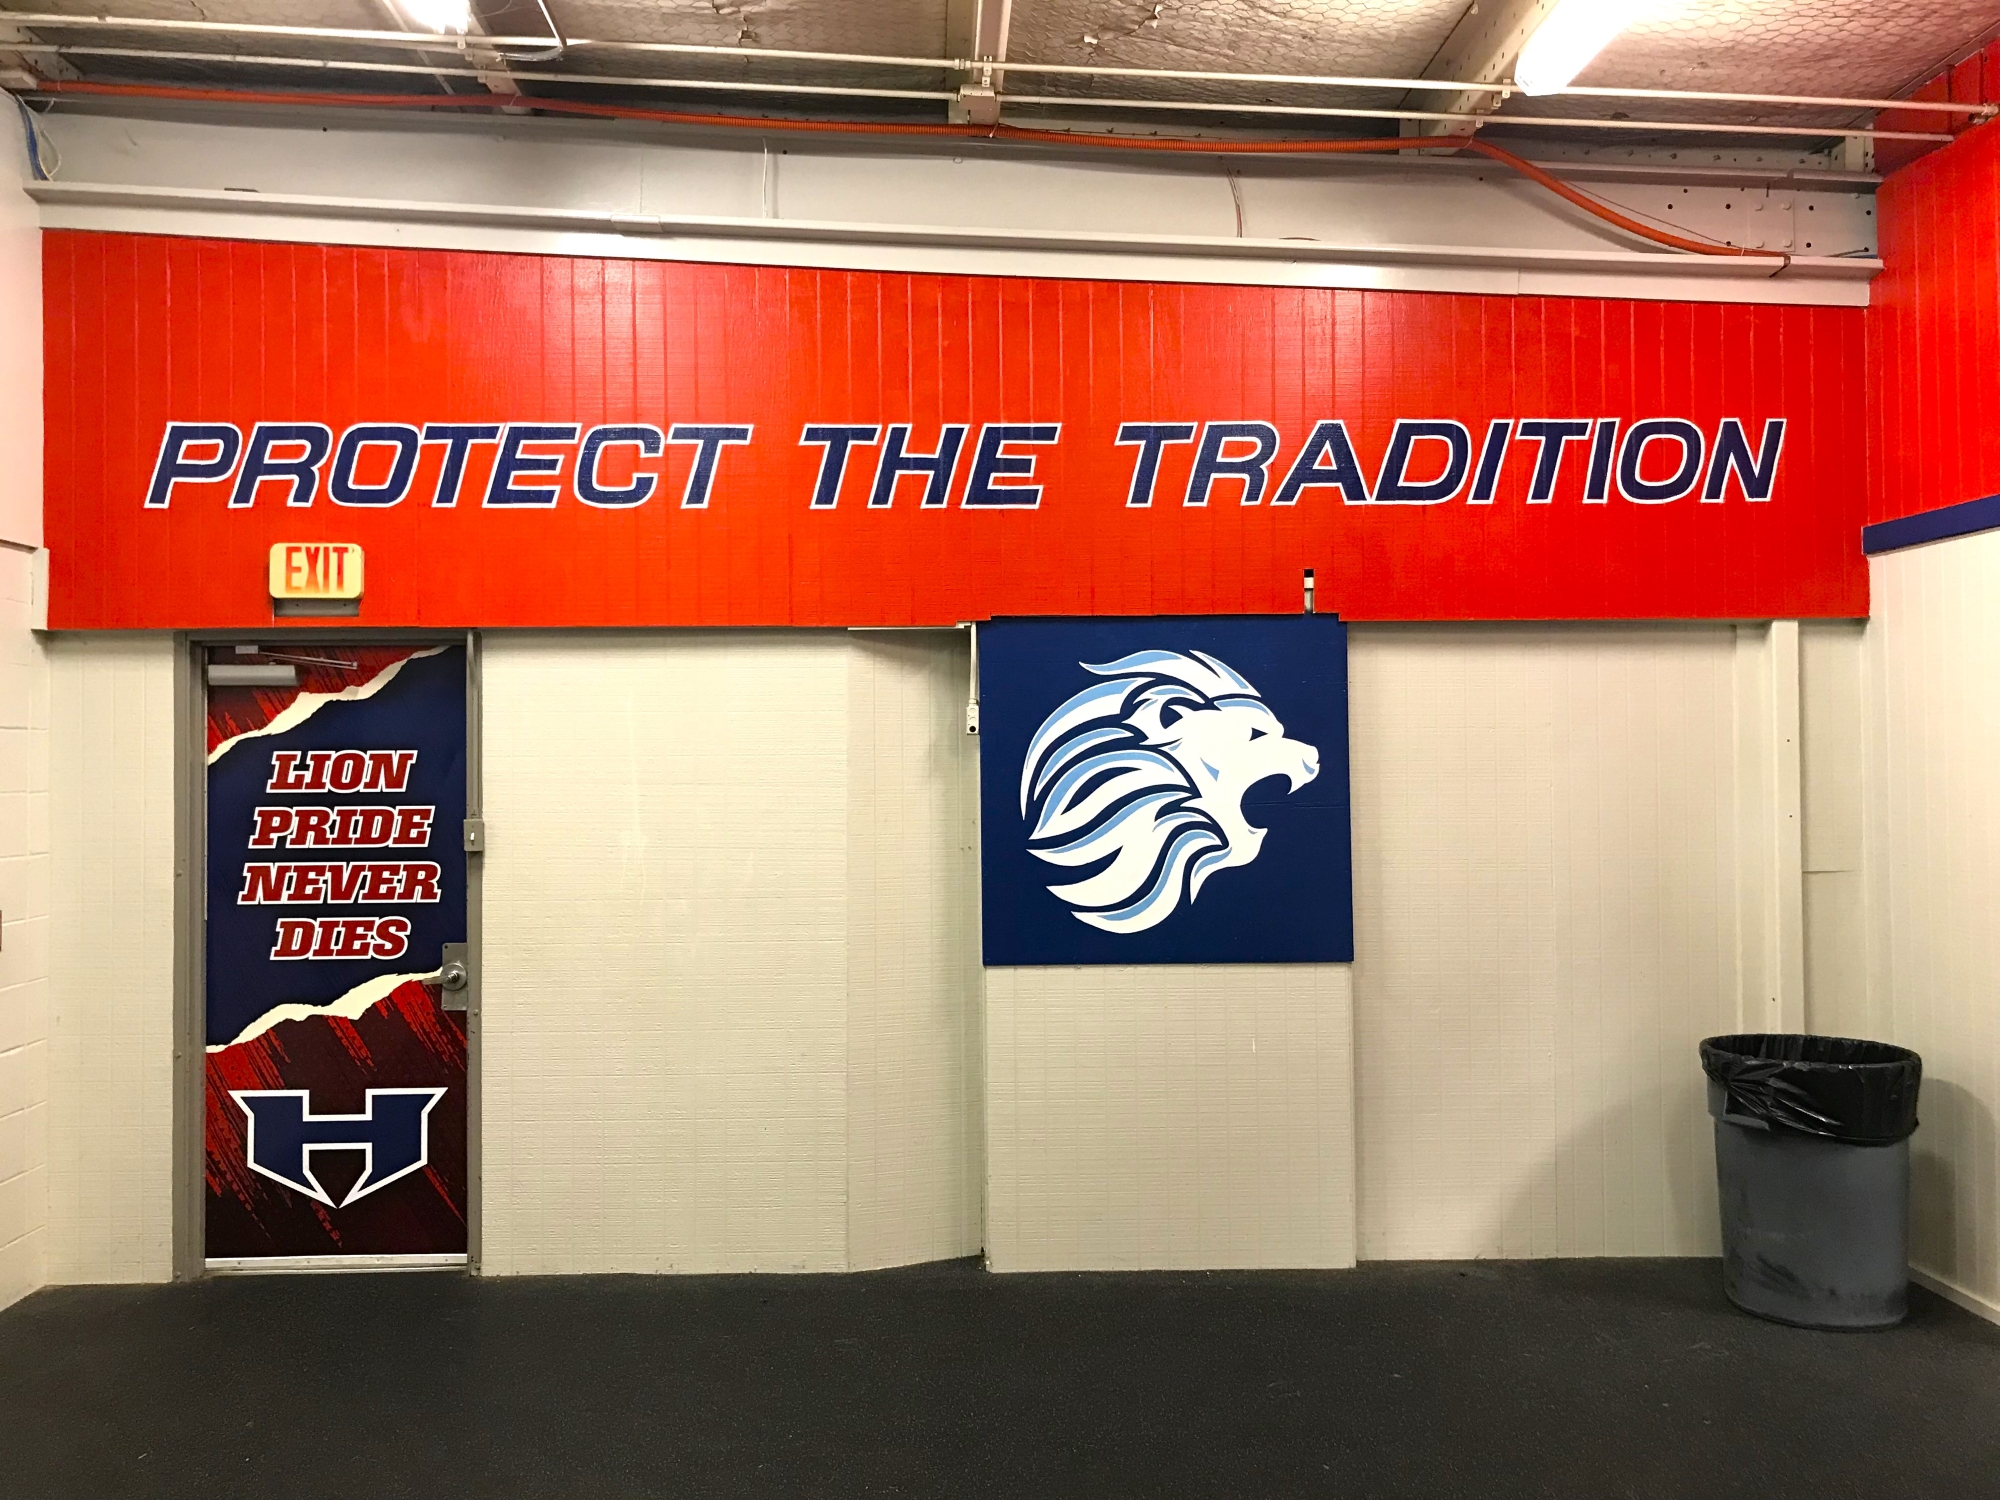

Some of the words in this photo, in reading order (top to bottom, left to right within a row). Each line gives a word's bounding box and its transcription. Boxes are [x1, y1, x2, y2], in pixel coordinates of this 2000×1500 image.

[144, 421, 752, 508] PROTECT
[798, 422, 1062, 509] THE
[1115, 418, 1787, 507] TRADITION
[284, 546, 350, 594] EXIT
[267, 750, 416, 793] LION
[248, 805, 435, 849] PRIDE
[237, 861, 441, 905] NEVER
[270, 916, 411, 961] DIES
